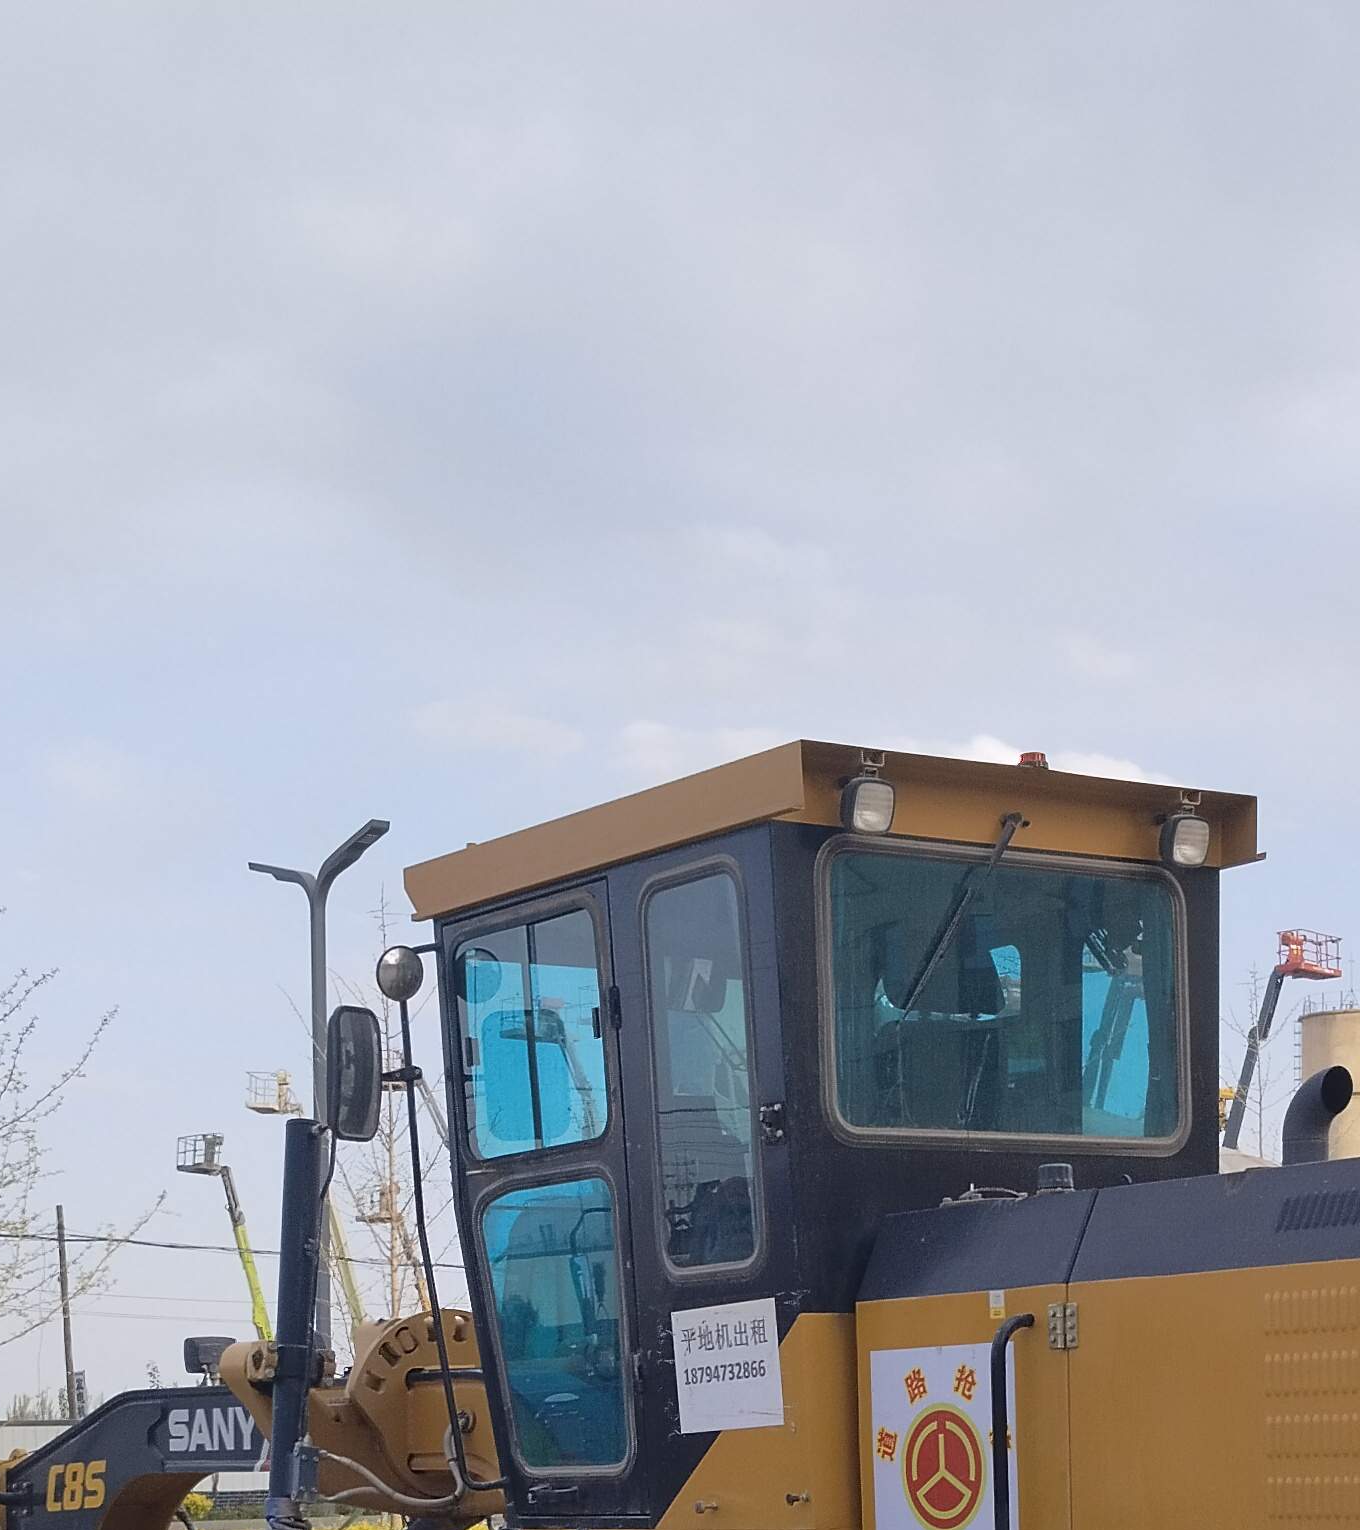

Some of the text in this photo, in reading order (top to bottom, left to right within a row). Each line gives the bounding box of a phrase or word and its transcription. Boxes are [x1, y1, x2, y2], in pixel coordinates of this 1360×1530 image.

[680, 1315, 769, 1355] 平地机出租
[683, 1359, 767, 1386] 18794732866
[168, 1406, 256, 1453] SANY
[46, 1459, 108, 1513] C8S
